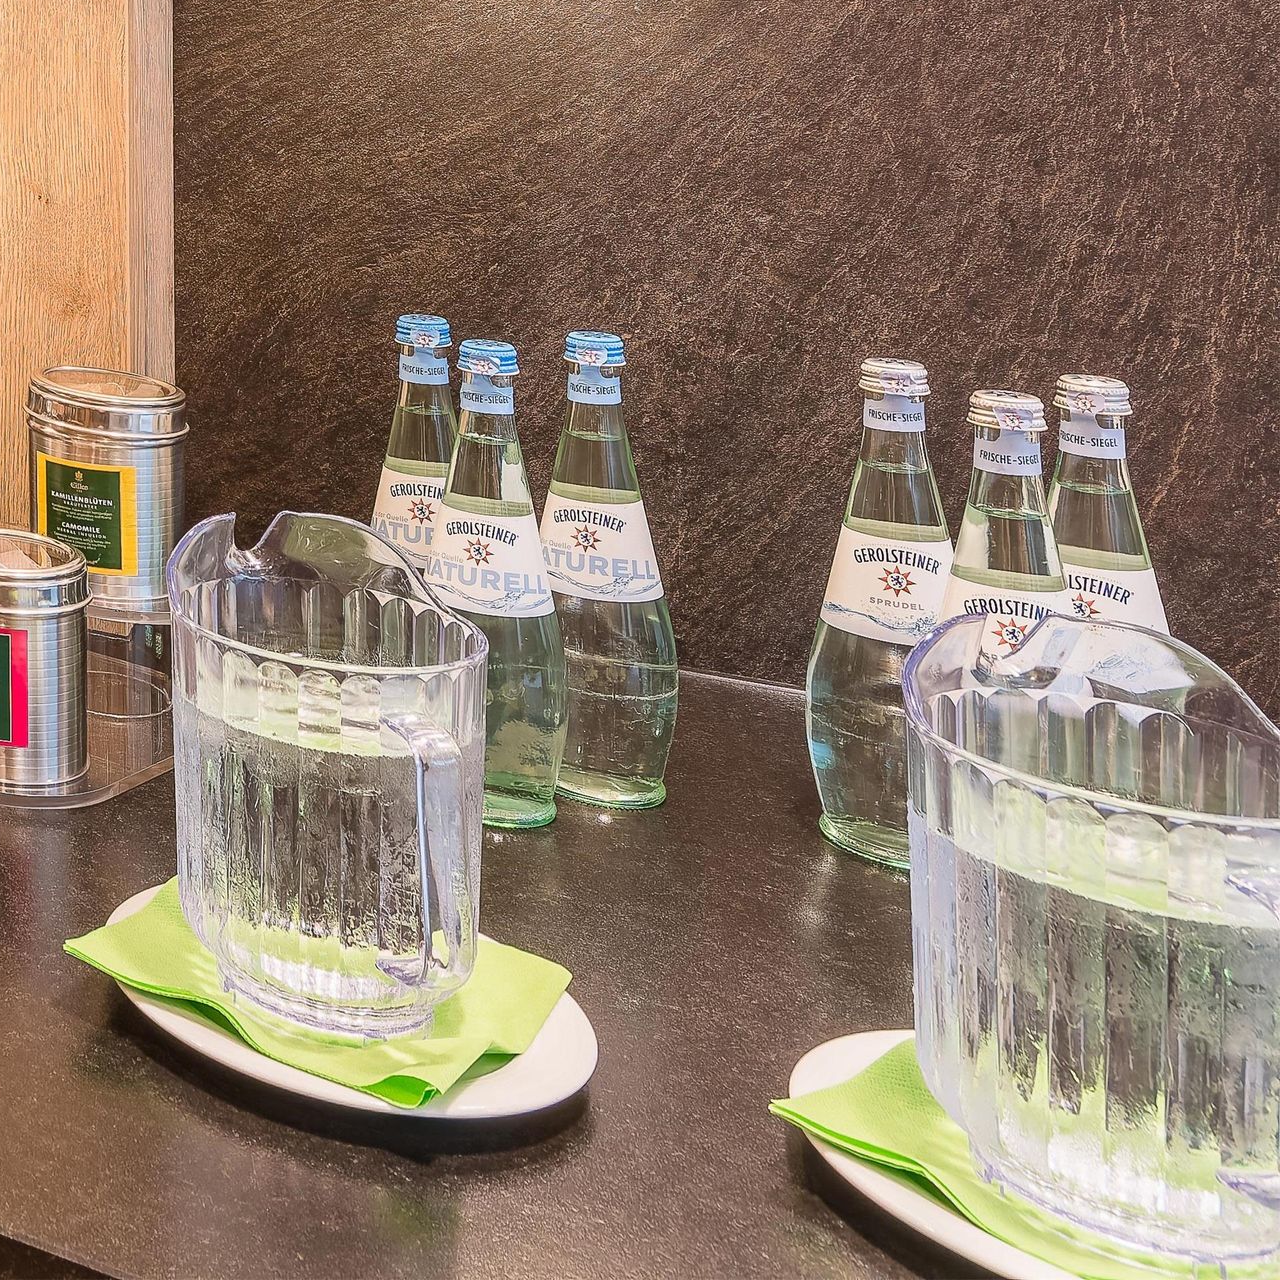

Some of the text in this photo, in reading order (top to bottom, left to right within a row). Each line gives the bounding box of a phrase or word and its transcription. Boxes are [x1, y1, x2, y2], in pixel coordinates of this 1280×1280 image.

[401, 362, 446, 377] FRISCHE-SIEGEL
[868, 408, 923, 422] FRISCHE-SIEGEL
[979, 449, 1040, 465] FRISCHE-SIEGEL
[51, 490, 113, 507] KAMILLENBLÜTEN
[390, 483, 444, 500] GEROLSTEIN
[61, 521, 101, 534] CAMOMILE
[553, 509, 625, 533] GEROLSTEINER
[446, 520, 516, 547] GEROLSTEINER
[542, 545, 656, 580] ATURELL
[853, 547, 940, 575] GEROLSTEINER
[1067, 573, 1132, 605] LSTEINER
[868, 596, 926, 612] SPRUDEL
